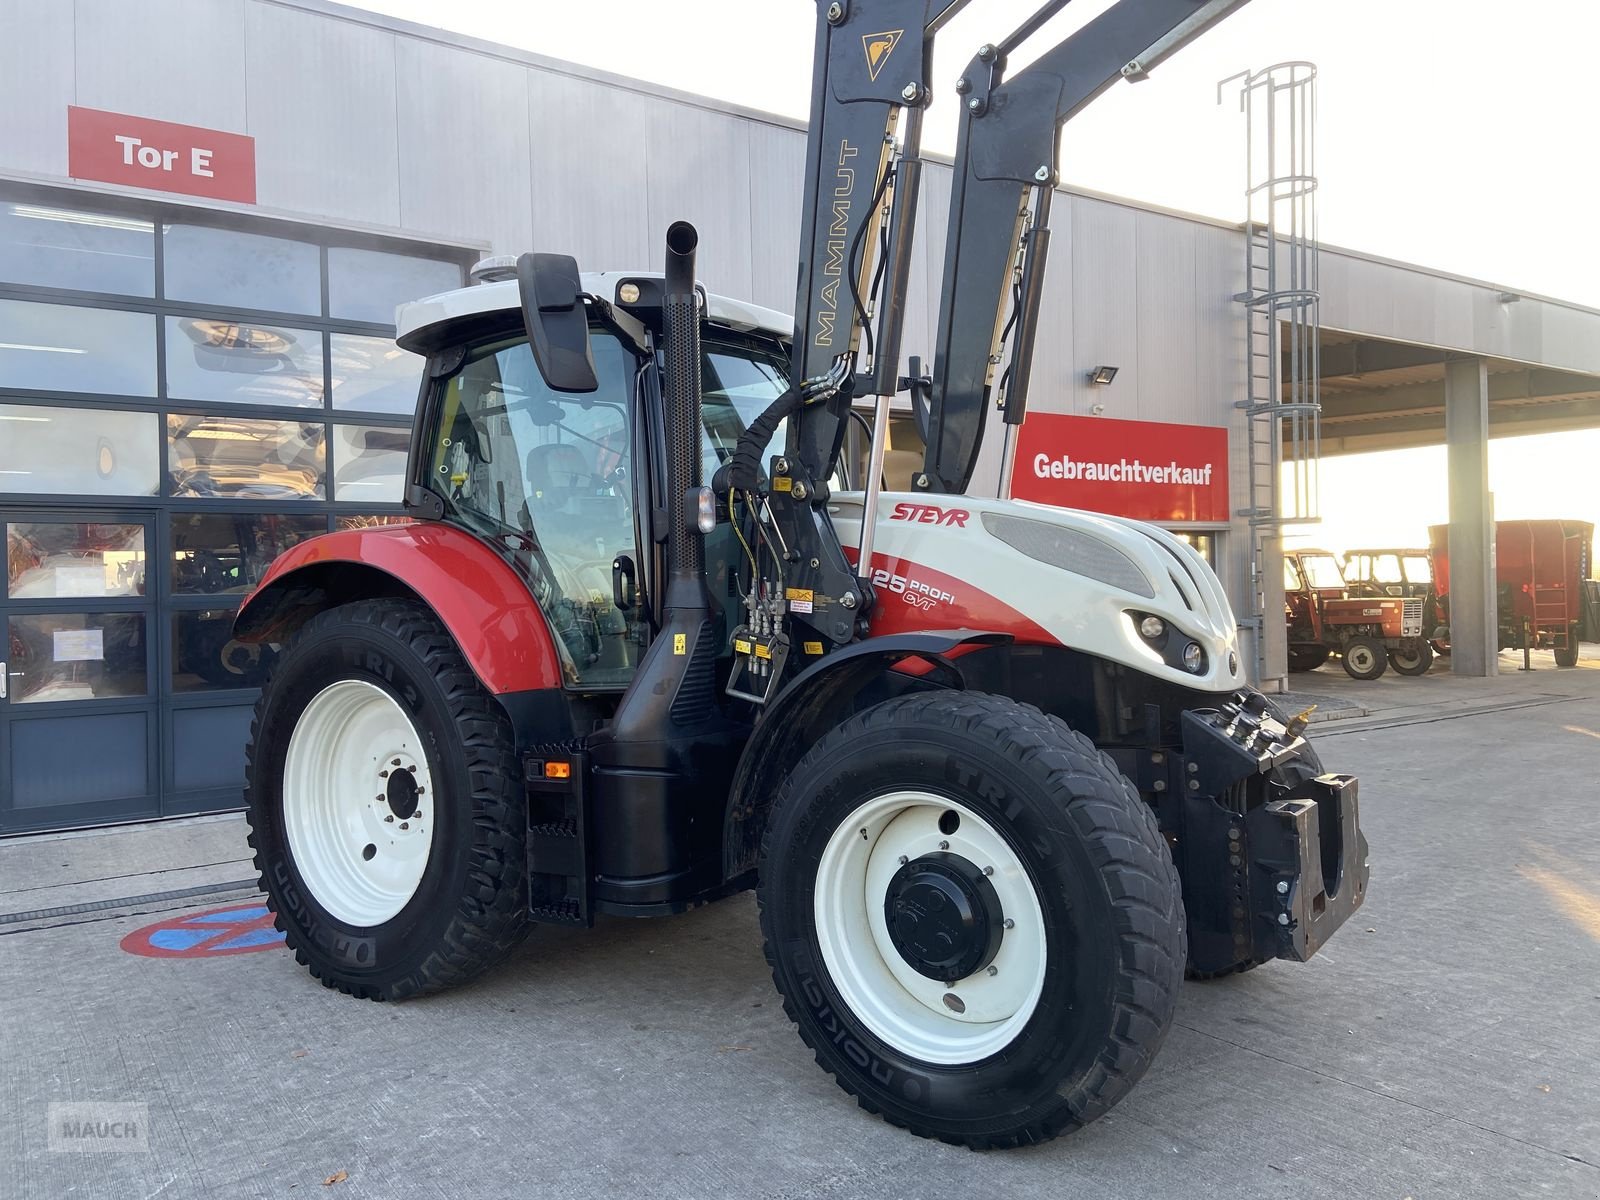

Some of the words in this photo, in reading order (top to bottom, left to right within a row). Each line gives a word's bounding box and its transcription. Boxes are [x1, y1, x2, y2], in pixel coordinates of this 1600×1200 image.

[114, 134, 179, 172] Tor
[191, 147, 214, 178] E
[815, 139, 858, 346] MAMMUT
[1033, 453, 1212, 485] Gebrauchtverkauf
[889, 502, 970, 528] STEYR
[869, 567, 908, 594] 25
[909, 579, 955, 605] PROFI
[902, 590, 937, 611] CVT
[953, 759, 1027, 822] TRI
